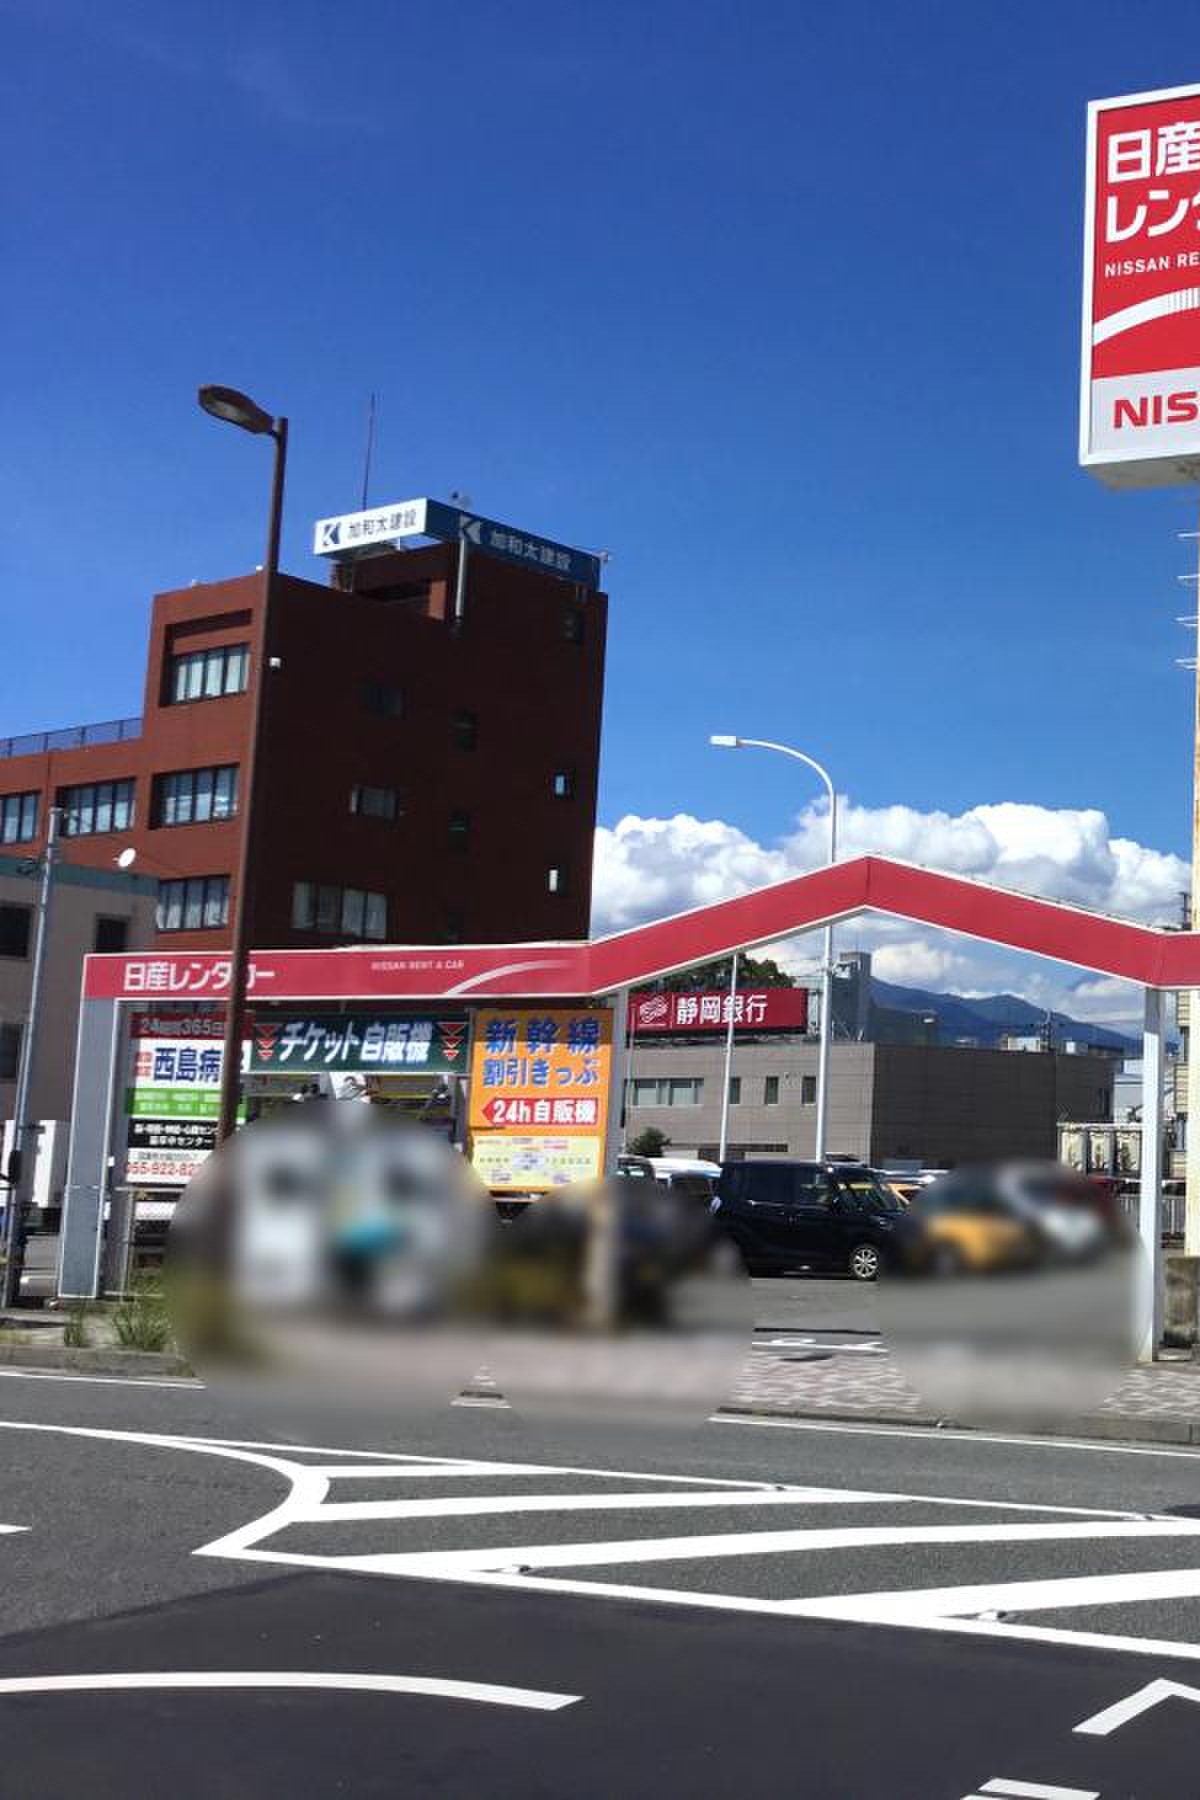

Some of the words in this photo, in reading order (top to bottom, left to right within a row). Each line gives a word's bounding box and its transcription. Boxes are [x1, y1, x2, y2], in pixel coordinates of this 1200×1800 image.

[1105, 255, 1170, 278] NISSAN
[124, 961, 275, 990] 日産レンター
[676, 995, 768, 1025] 静岡銀行
[279, 1021, 433, 1063] チケット自販機
[485, 1016, 600, 1055] 新幹線
[153, 1047, 245, 1083] 西島病
[483, 1058, 600, 1087] 割引きっぷ
[492, 1100, 598, 1124] 24h自販機
